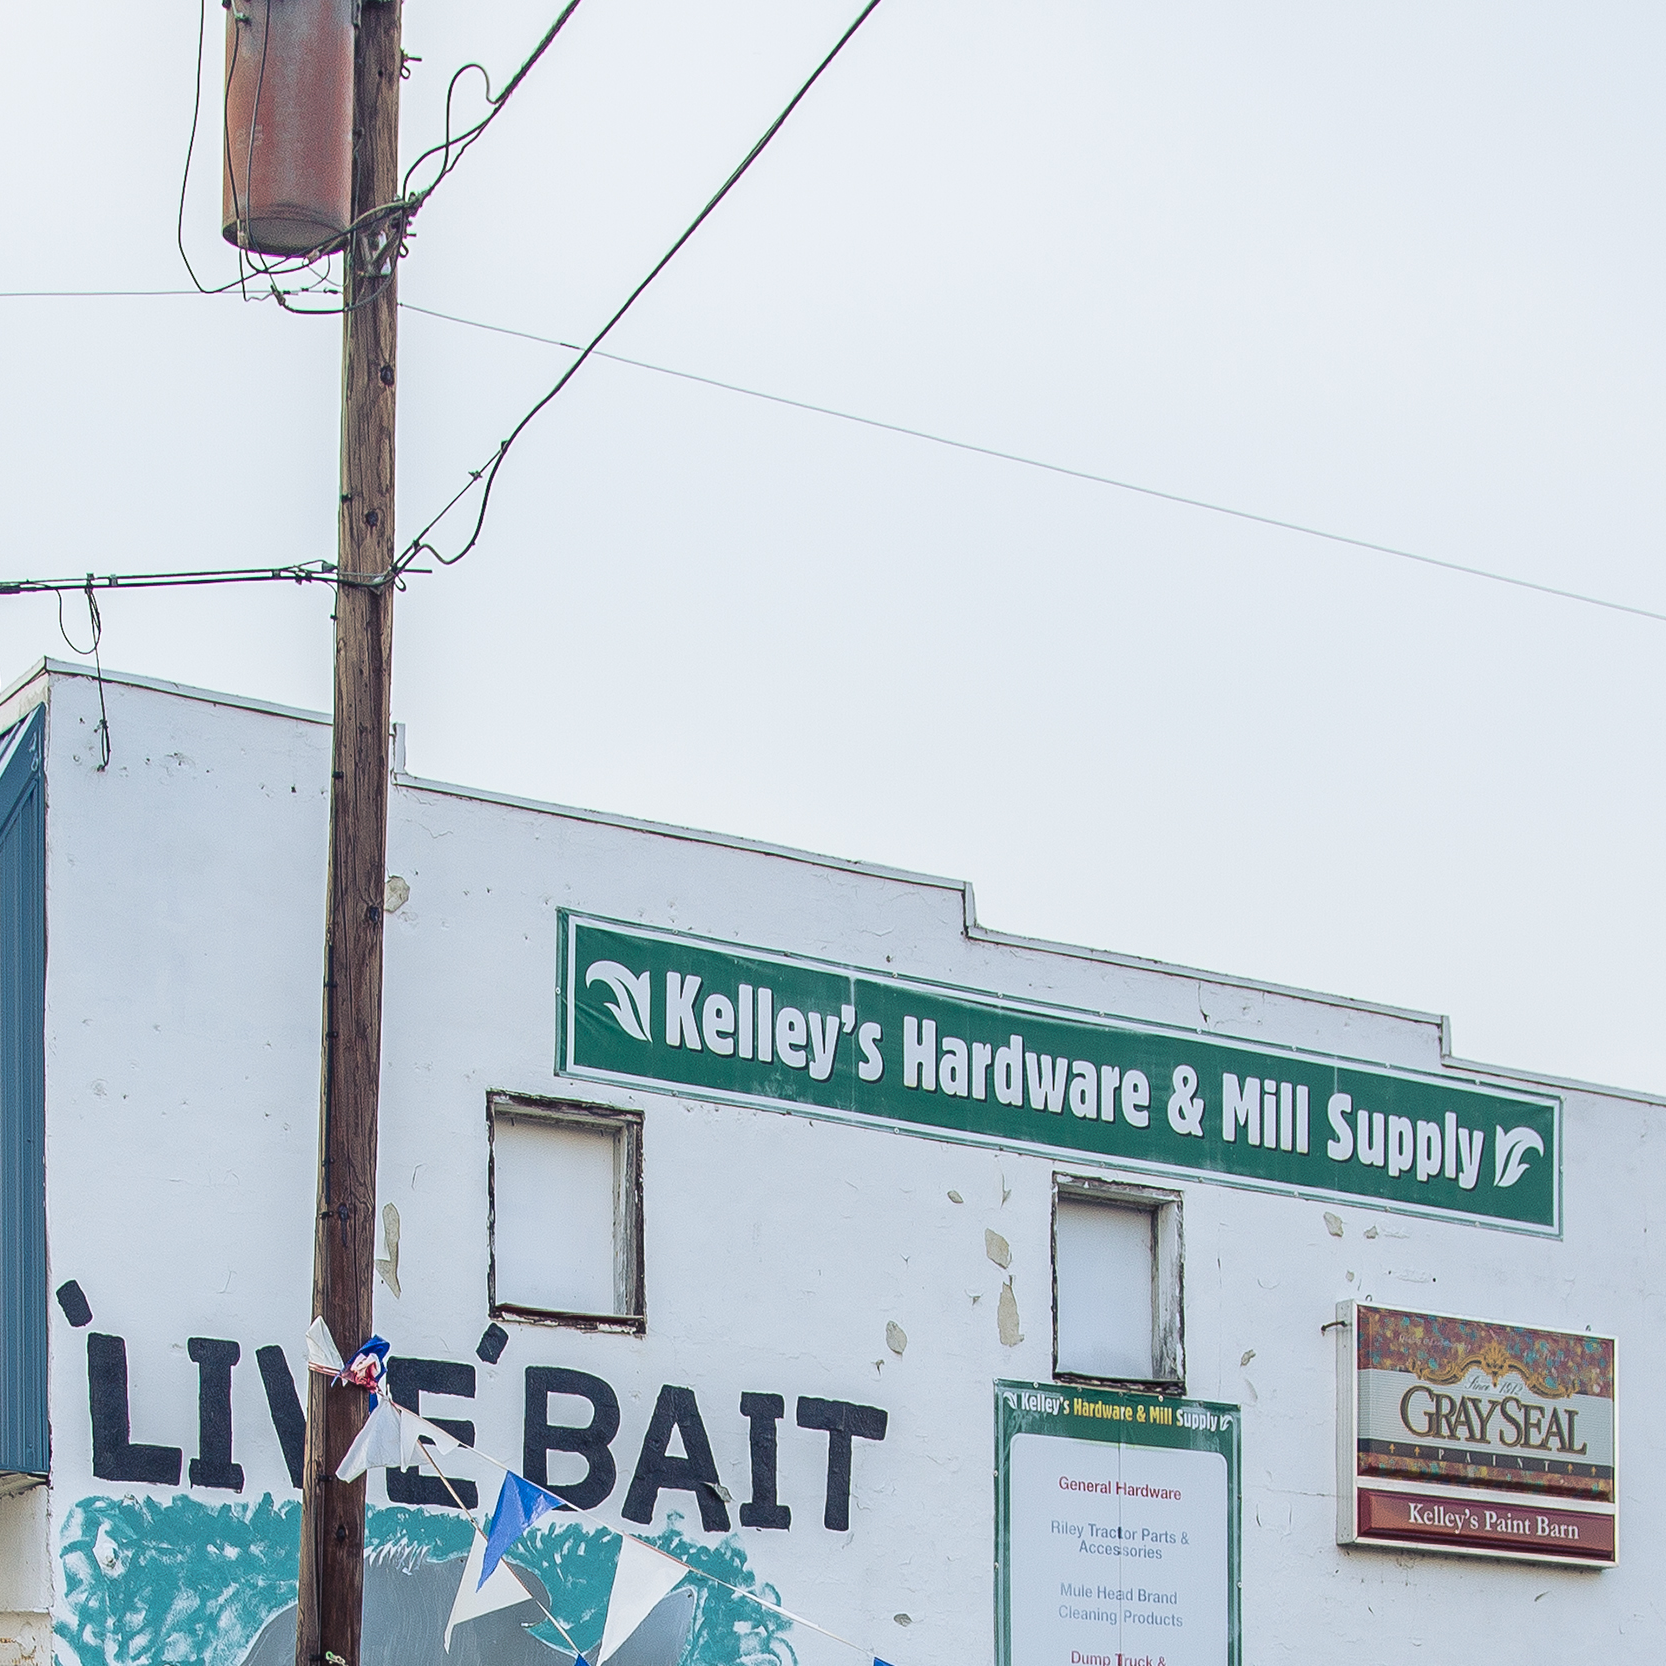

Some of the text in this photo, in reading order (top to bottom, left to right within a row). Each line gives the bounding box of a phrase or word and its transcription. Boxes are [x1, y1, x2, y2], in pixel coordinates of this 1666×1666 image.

[663, 969, 1486, 1192] Kelley's Hardware & Mill Supply
[1021, 1392, 1218, 1432] Kelley's Hardware & Mill Supply
[522, 1364, 889, 1532] BAIT
[1438, 1449, 1551, 1472] PAINT
[1058, 1476, 1182, 1501] General Hardware
[1051, 1520, 1190, 1545] Riley Tractor Parts &
[1408, 1503, 1580, 1540] Kelley's Paint Barn
[1079, 1540, 1163, 1560] Accessories
[1060, 1582, 1178, 1605] Mule Head Brand
[1058, 1604, 1183, 1628] Cleaning Products
